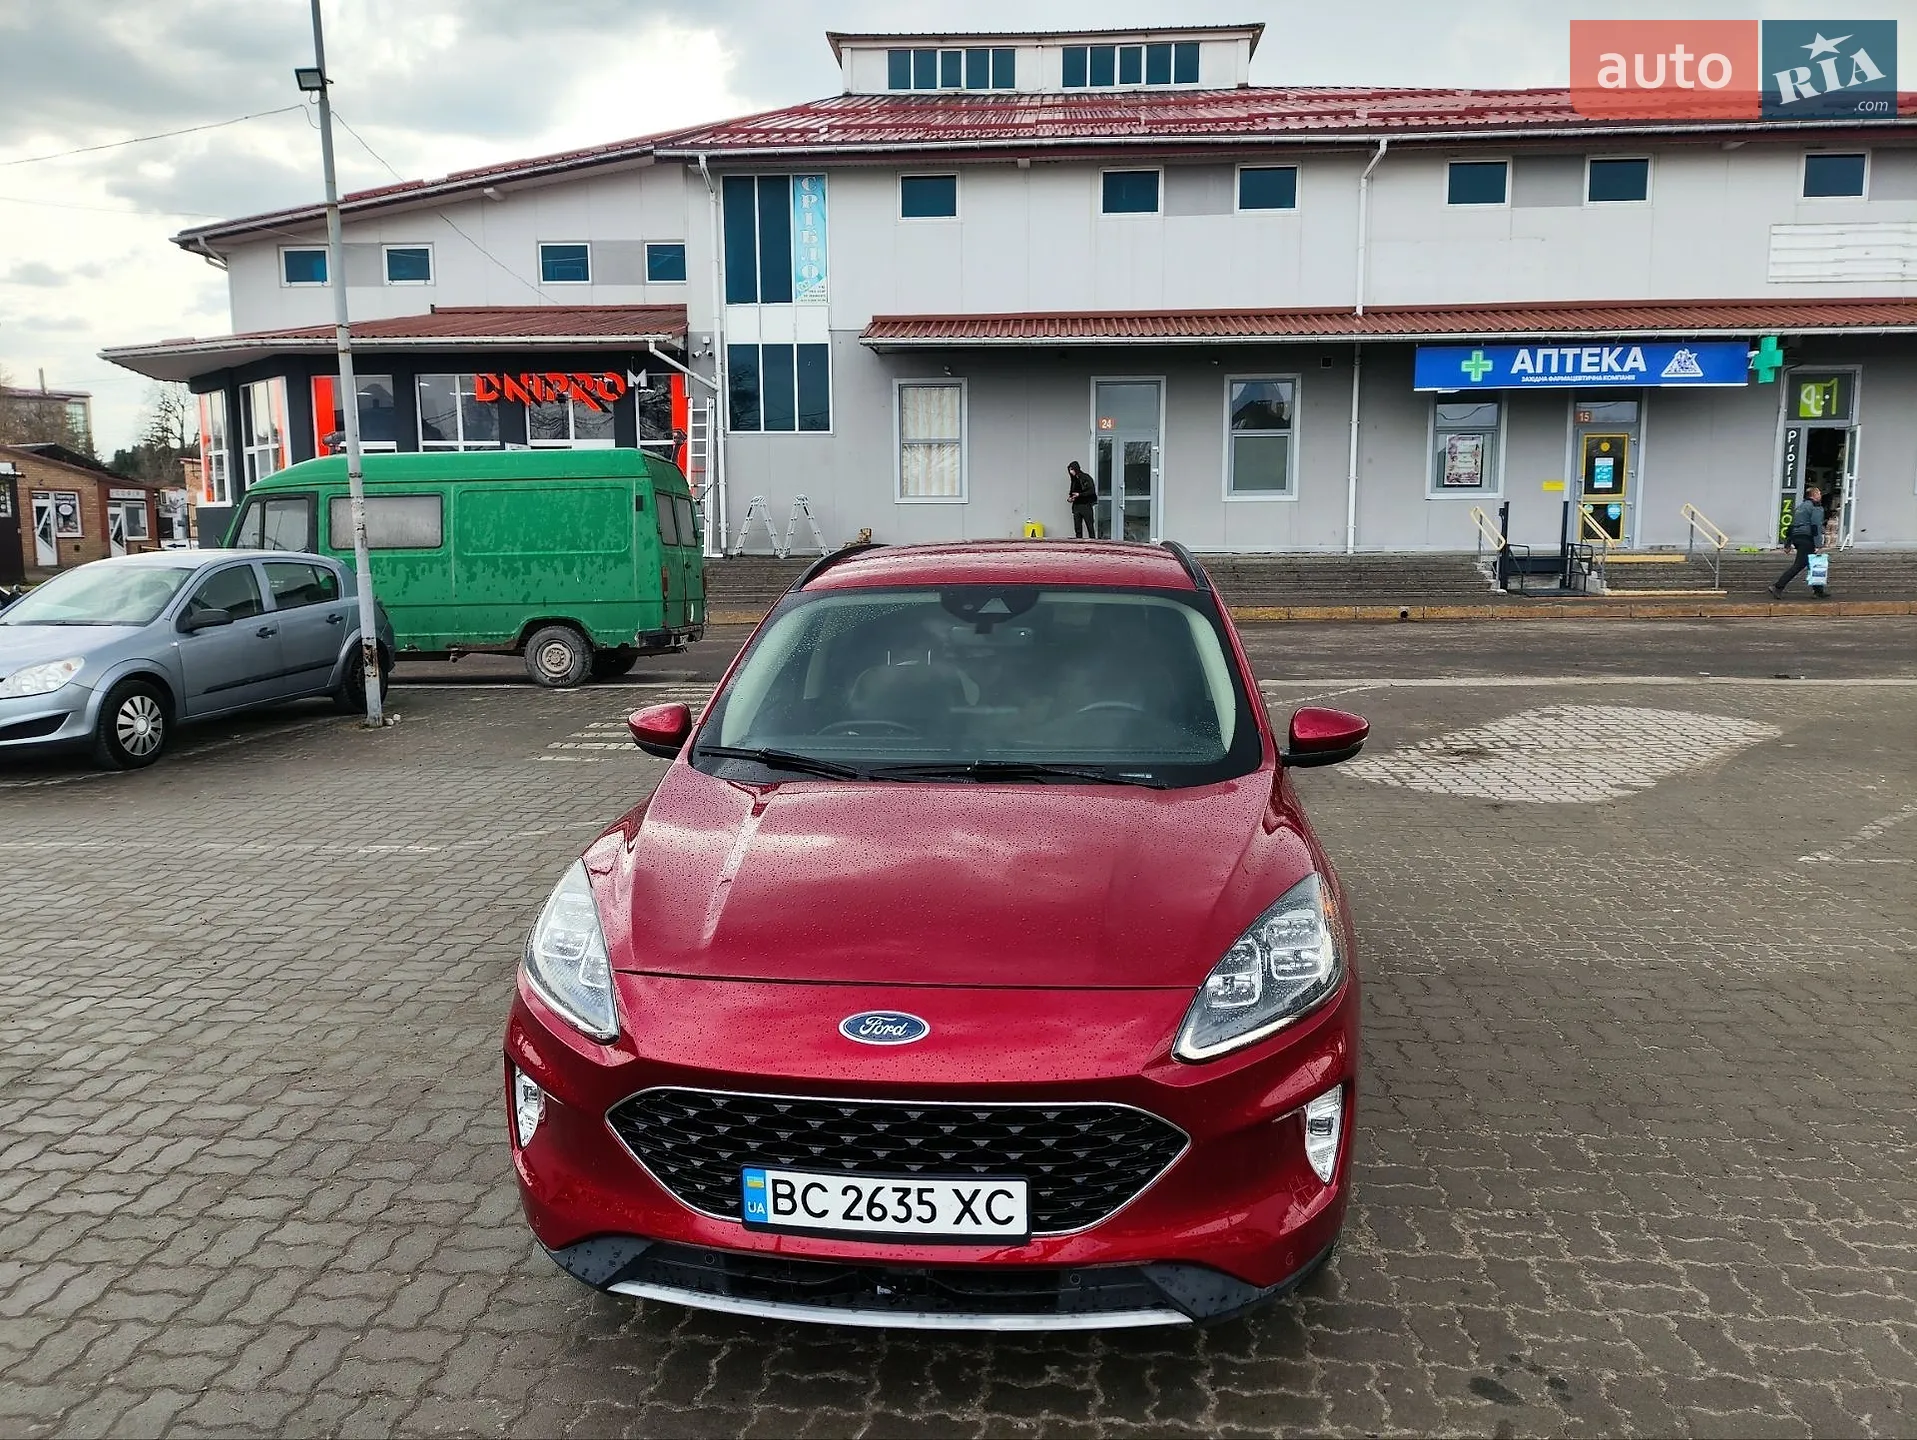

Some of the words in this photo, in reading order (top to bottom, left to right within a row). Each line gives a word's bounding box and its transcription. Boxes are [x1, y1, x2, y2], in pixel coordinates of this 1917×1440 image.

[801, 176, 819, 280] СРІБЛО
[1510, 346, 1648, 375] АПТЕКА
[475, 371, 627, 412] DNIPRO
[627, 369, 648, 388] M
[1101, 419, 1112, 429] 24
[1579, 411, 1591, 422] 15
[859, 1016, 909, 1036] Ford
[747, 1203, 766, 1215] UA
[771, 1178, 830, 1219] BC
[841, 1184, 937, 1225] 2635
[952, 1188, 1016, 1227] XC
